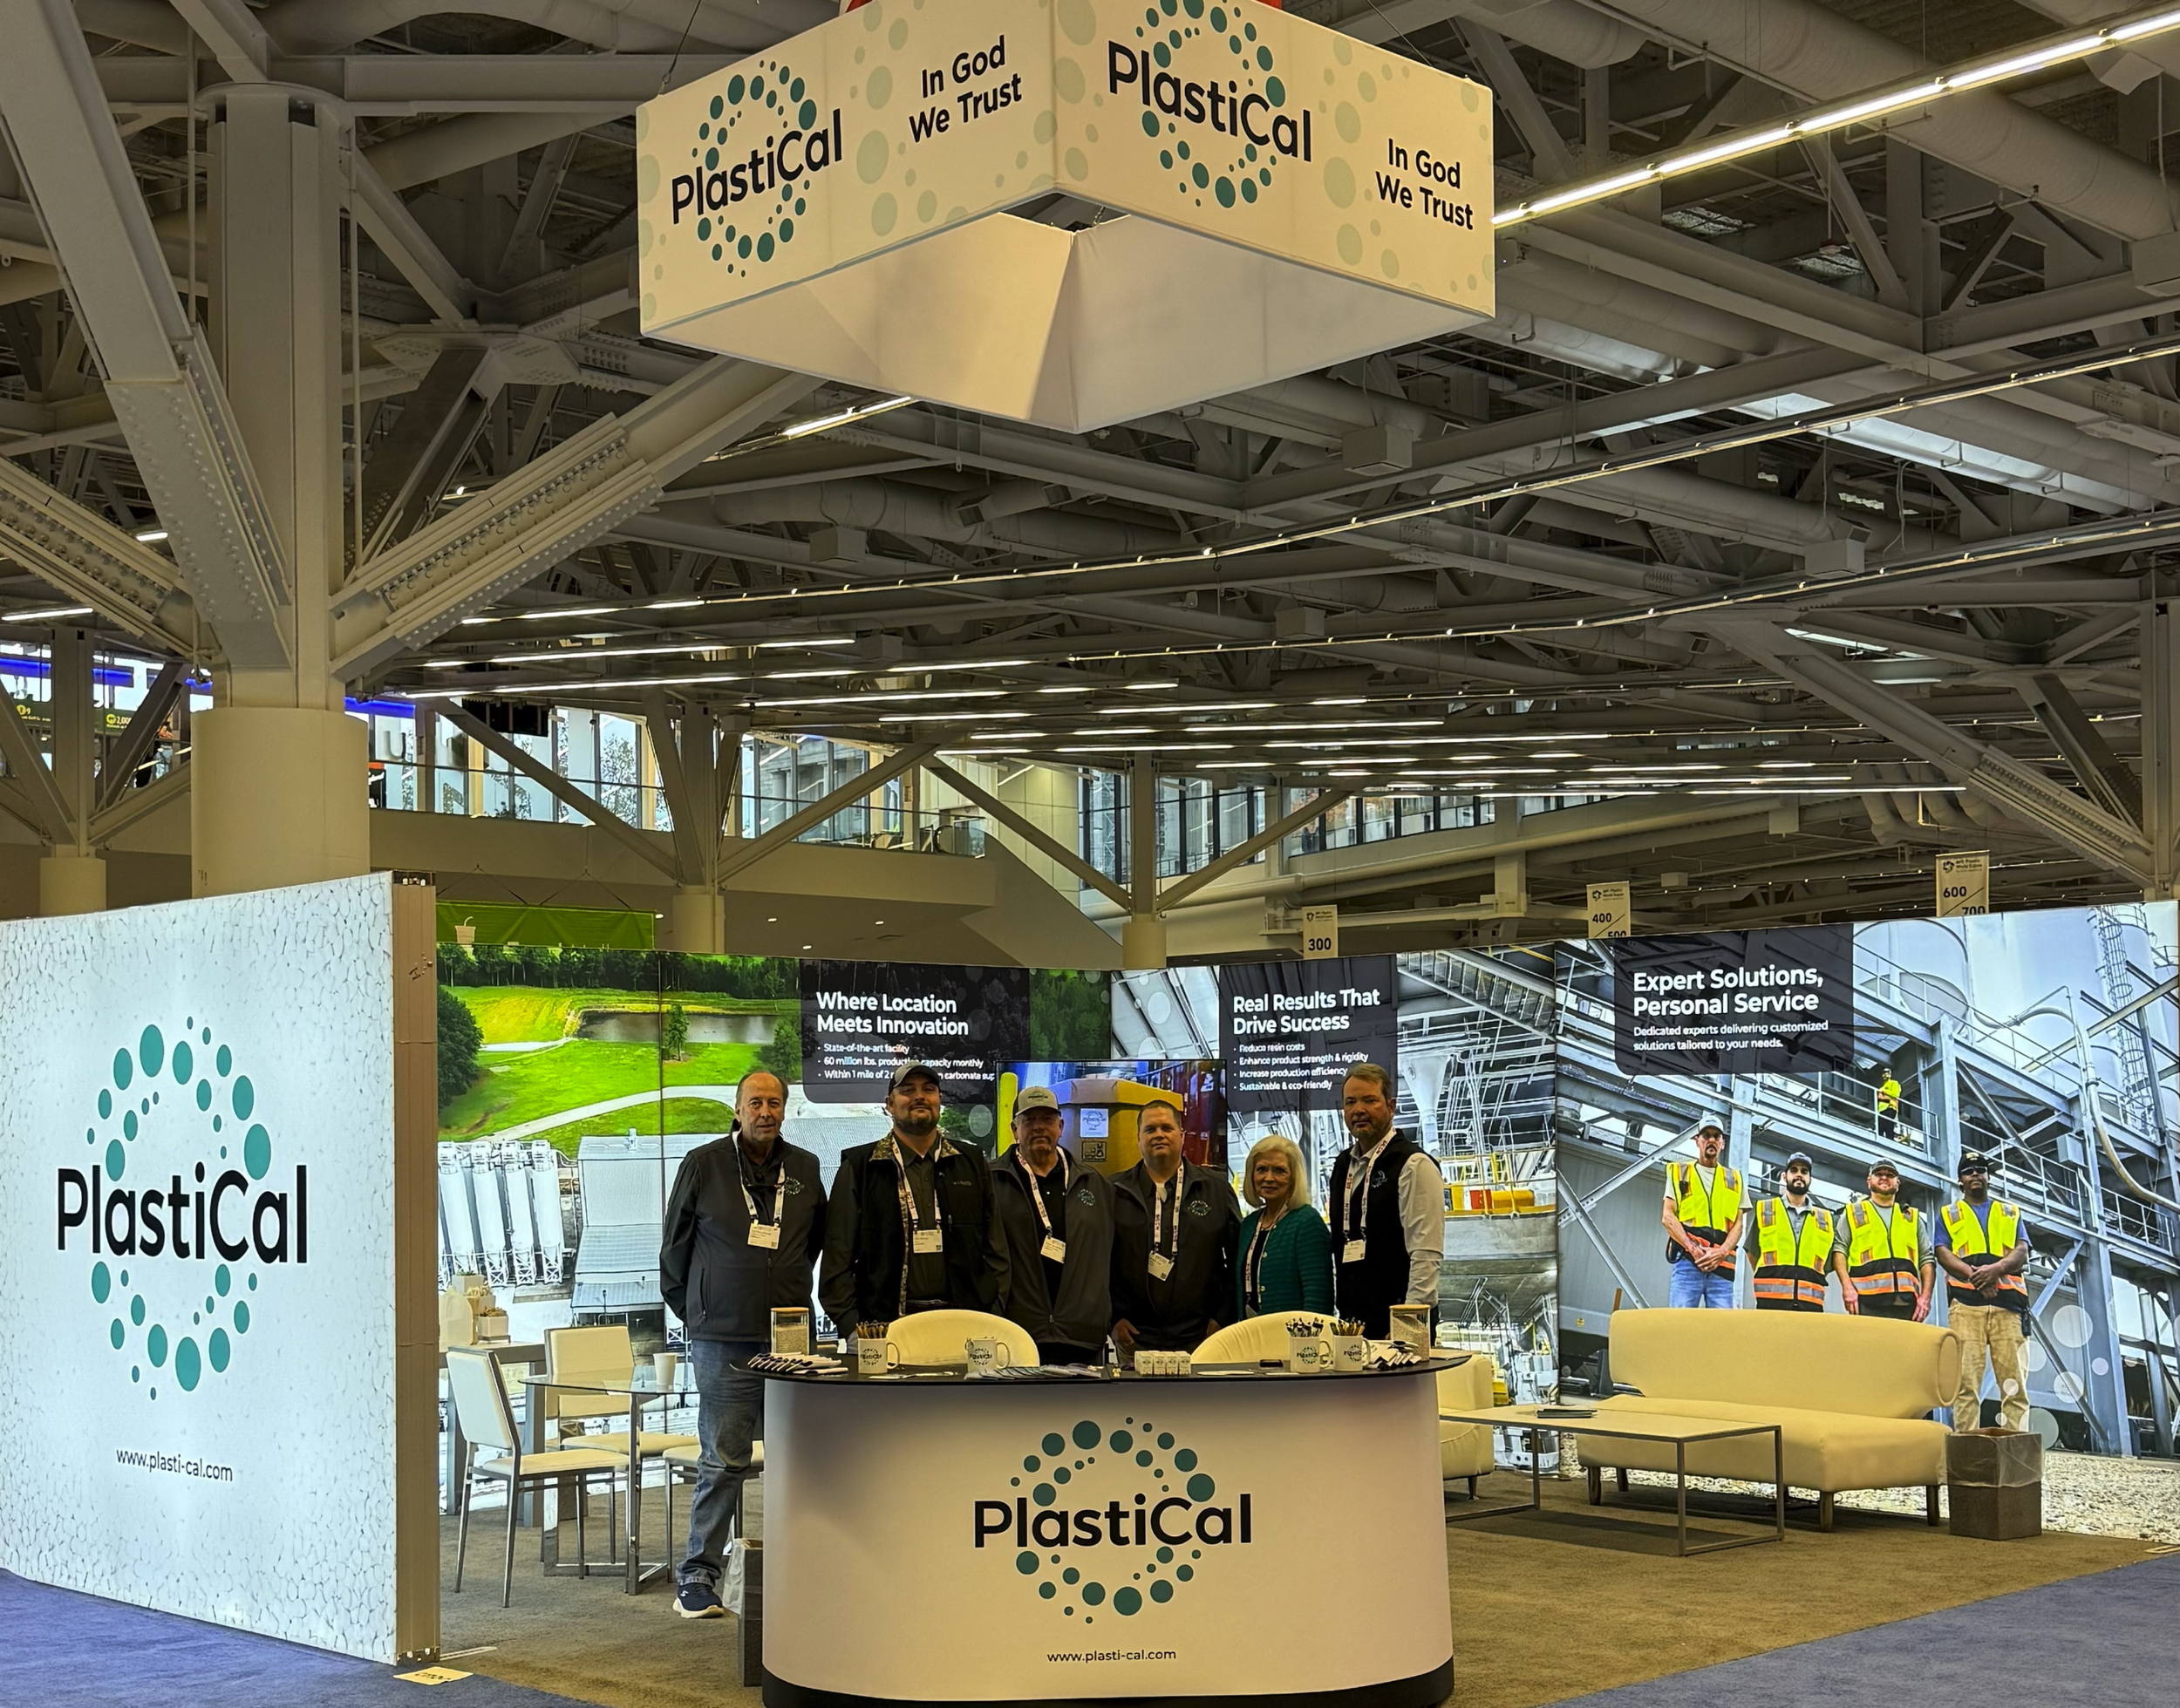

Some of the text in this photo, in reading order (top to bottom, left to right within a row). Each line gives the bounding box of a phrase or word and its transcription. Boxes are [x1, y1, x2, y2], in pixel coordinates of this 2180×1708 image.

[922, 34, 1005, 99] In God
[909, 73, 1022, 143] We Trust
[1108, 40, 1311, 162] PlastiCal
[672, 108, 842, 225] PlastiCal
[1388, 138, 1461, 189] In God
[1375, 171, 1474, 230] We Trust
[1943, 886, 1967, 899] 600
[1592, 913, 1612, 924] 400
[1961, 905, 1986, 916] 700
[1308, 937, 1332, 952] 300
[1633, 964, 1823, 996] Expert Solutions,
[816, 990, 957, 1013] Where Location
[1233, 988, 1380, 1012] Real Results That
[1633, 989, 1819, 1017] Personal Service
[817, 1014, 969, 1036] Meets Innovation
[1233, 1015, 1351, 1035] Drive Success
[1633, 1019, 1829, 1037] Dedicated experts delivering customized
[824, 1043, 909, 1055] State-of-the-art facility
[1239, 1045, 1266, 1053] Reduce
[1267, 1043, 1285, 1052] resin
[1633, 1038, 1783, 1051] solutions tailored to your needs.
[824, 1057, 835, 1065] 60
[835, 1056, 862, 1065] million
[921, 1058, 952, 1069] capacity
[953, 1058, 984, 1069] monthly
[1239, 1051, 1369, 1065] Enhance product strength & rigidity
[824, 1070, 851, 1079] Within
[857, 1070, 874, 1079] mile
[875, 1070, 884, 1079] of
[944, 1072, 981, 1080] carbonate
[1271, 1068, 1310, 1079] production
[1311, 1065, 1348, 1077] efficiency
[1239, 1080, 1332, 1091] Sustainable & eco-friendly
[58, 1161, 308, 1264] PlastiCal
[116, 1449, 233, 1482] www.plasti-cal.com
[974, 1494, 1251, 1548] PlastiCal
[1046, 1650, 1176, 1664] www.plasti-cal.com
